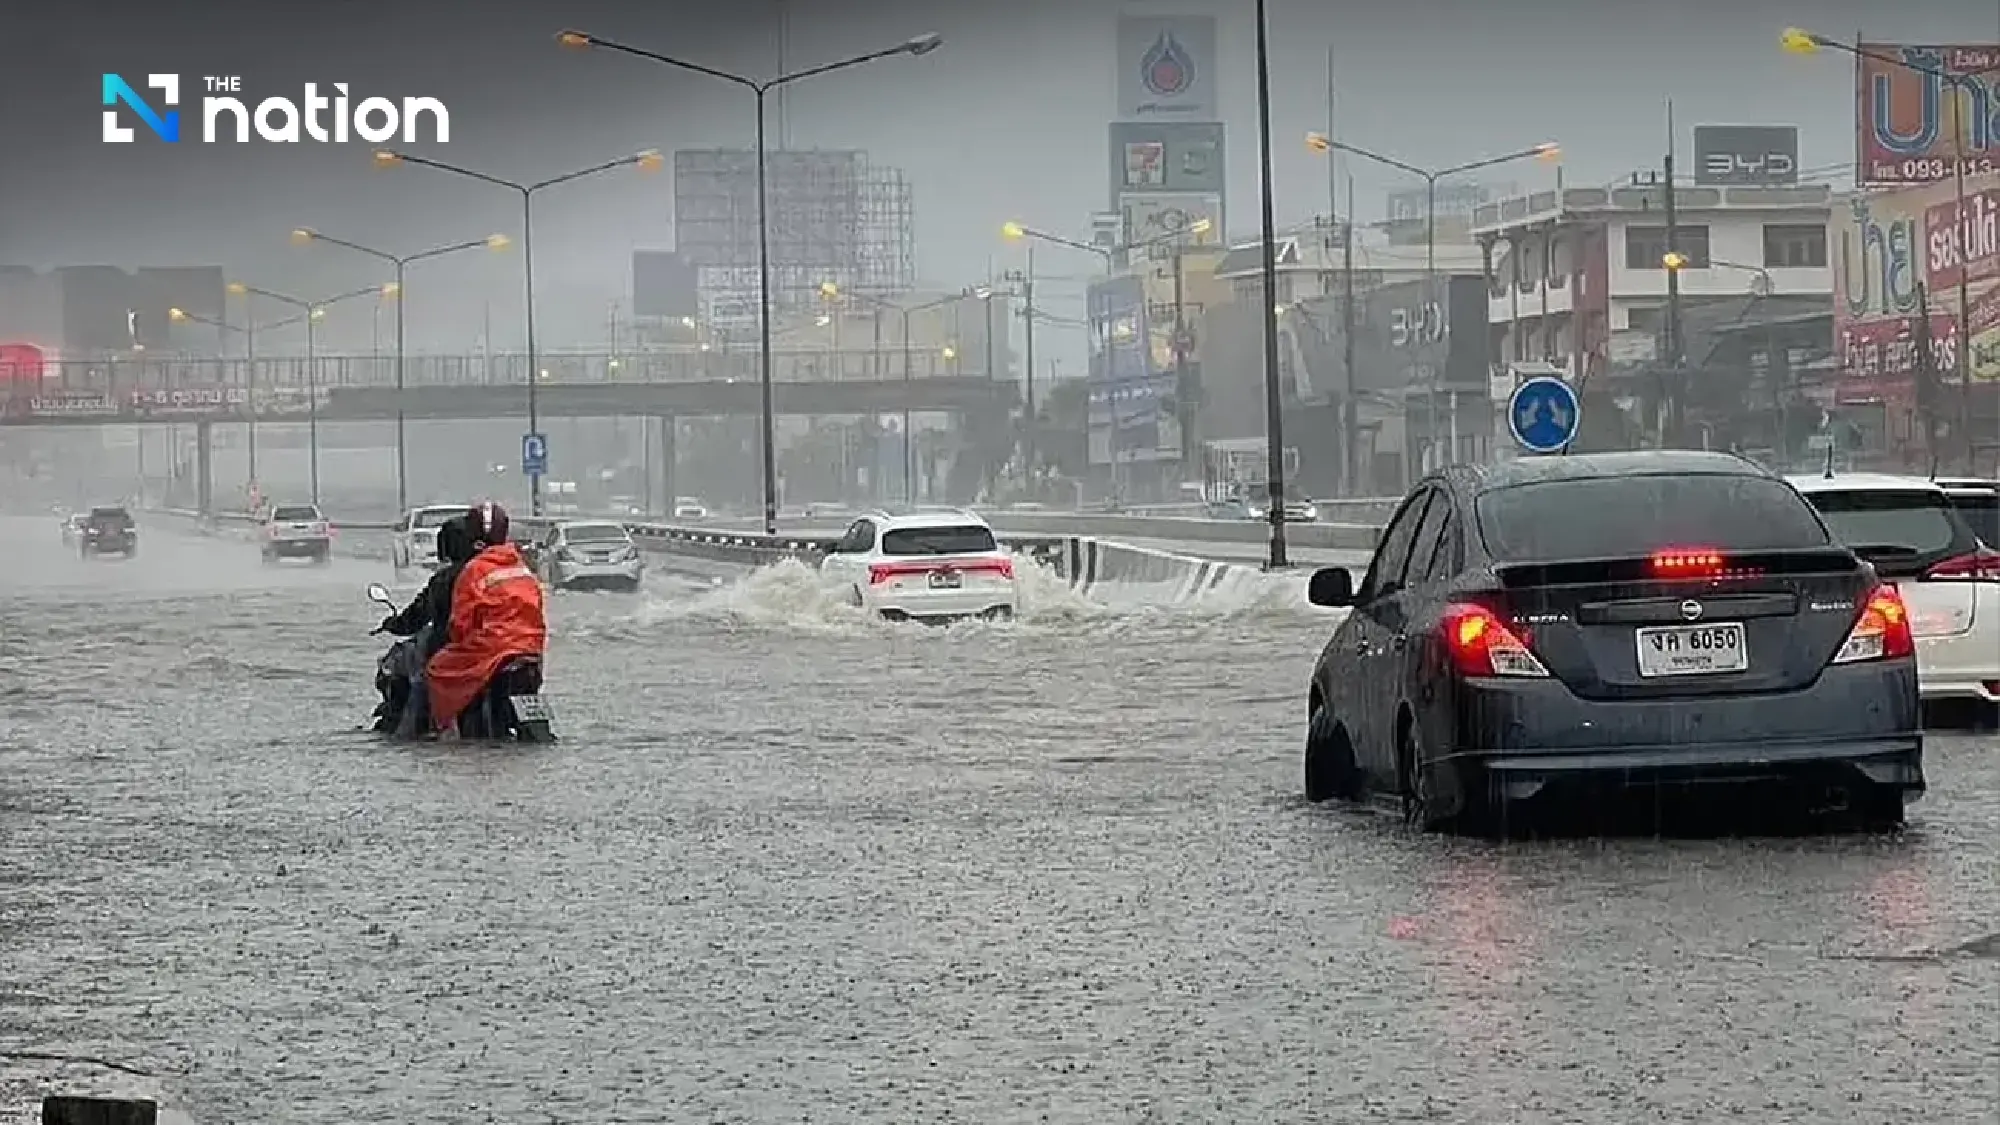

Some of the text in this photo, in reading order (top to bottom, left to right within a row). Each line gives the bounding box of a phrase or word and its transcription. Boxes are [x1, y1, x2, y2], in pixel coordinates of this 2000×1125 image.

[1872, 46, 2000, 153] ป้า
[1704, 153, 1794, 175] BYD
[1842, 198, 1917, 317] ป้าย
[1690, 629, 1737, 650] 6050
